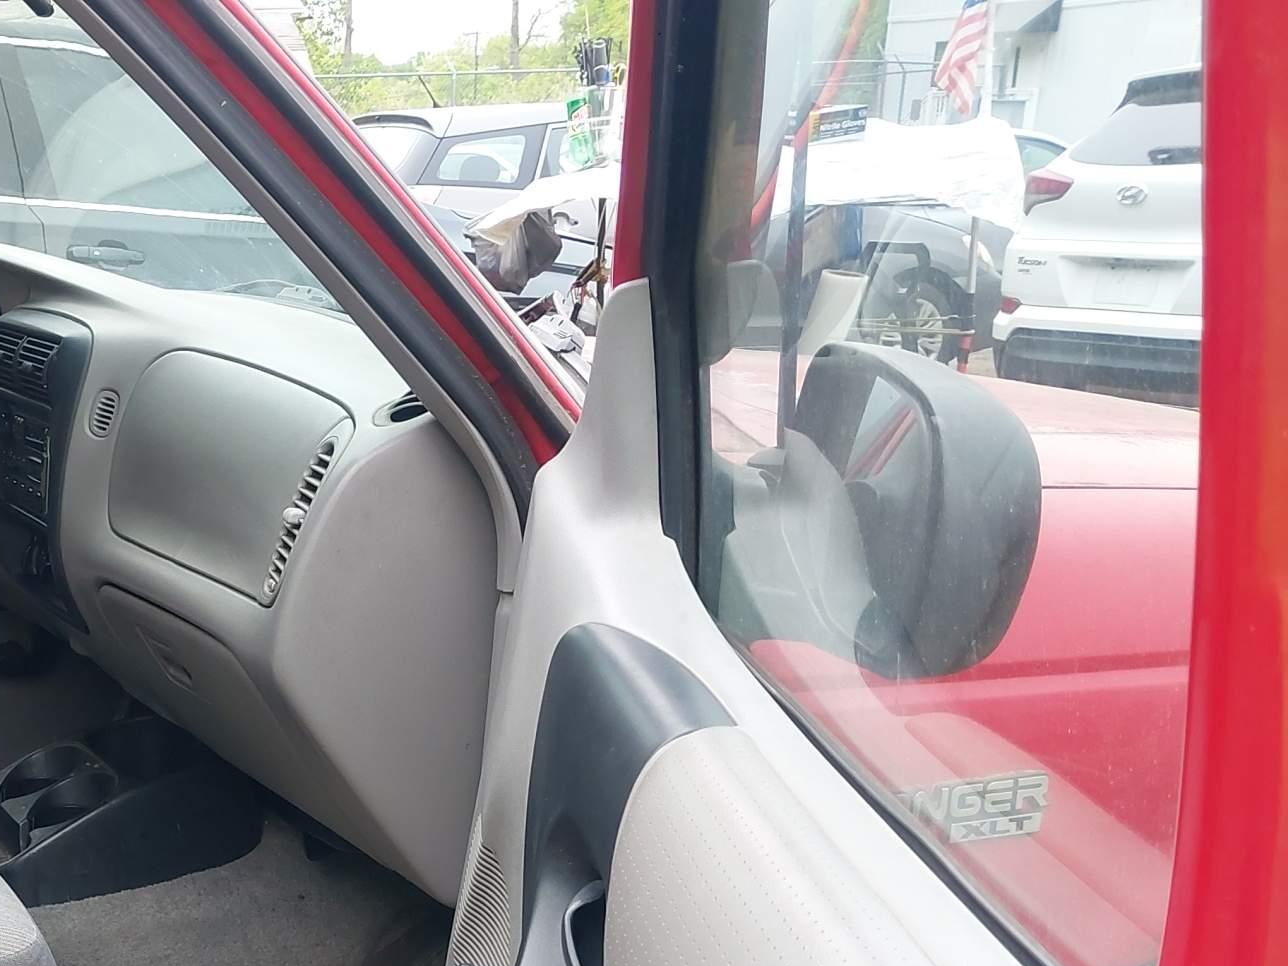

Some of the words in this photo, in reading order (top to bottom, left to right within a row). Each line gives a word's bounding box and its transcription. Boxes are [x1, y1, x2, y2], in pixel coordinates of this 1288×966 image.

[841, 119, 866, 129] Gloves
[896, 774, 1050, 820] NGER
[960, 815, 1034, 840] XLT
